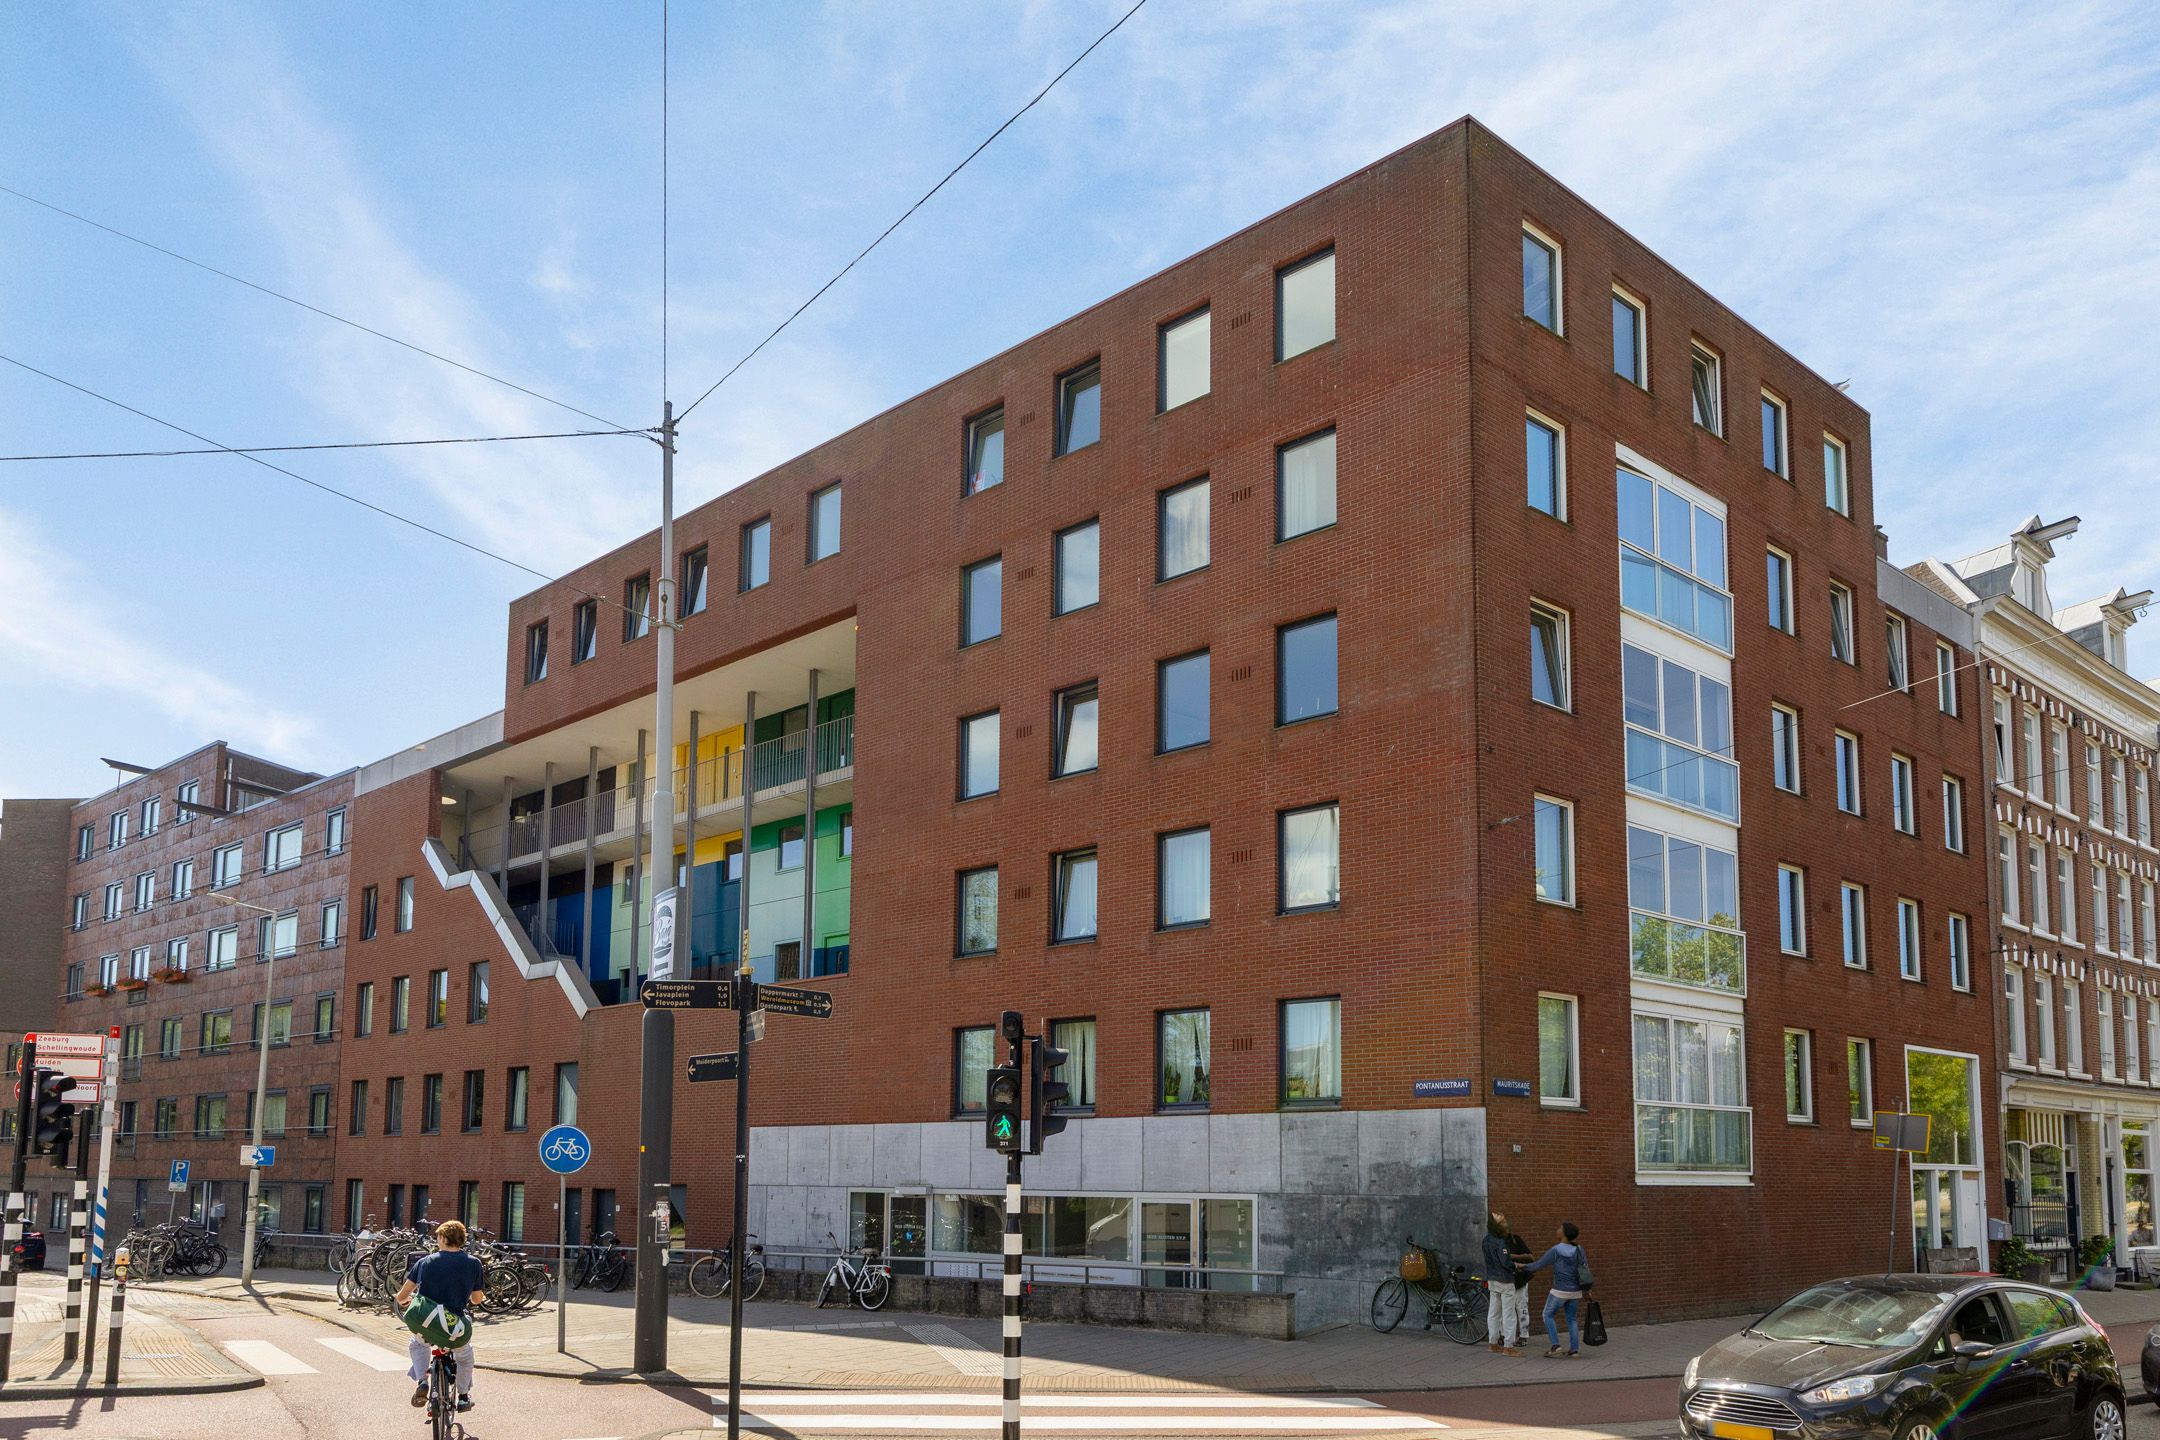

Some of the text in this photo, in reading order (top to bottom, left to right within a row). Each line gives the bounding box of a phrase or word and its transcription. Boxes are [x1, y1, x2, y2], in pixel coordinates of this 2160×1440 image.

[655, 983, 695, 991] Timorplein
[655, 991, 690, 999] Javaplein
[760, 988, 799, 997] Dappermarkt
[655, 999, 691, 1007] Flevopark
[37, 1035, 70, 1043] Zeeburg
[1415, 1080, 1469, 1090] PONTANUSSTRAAT
[175, 1161, 186, 1173] P
